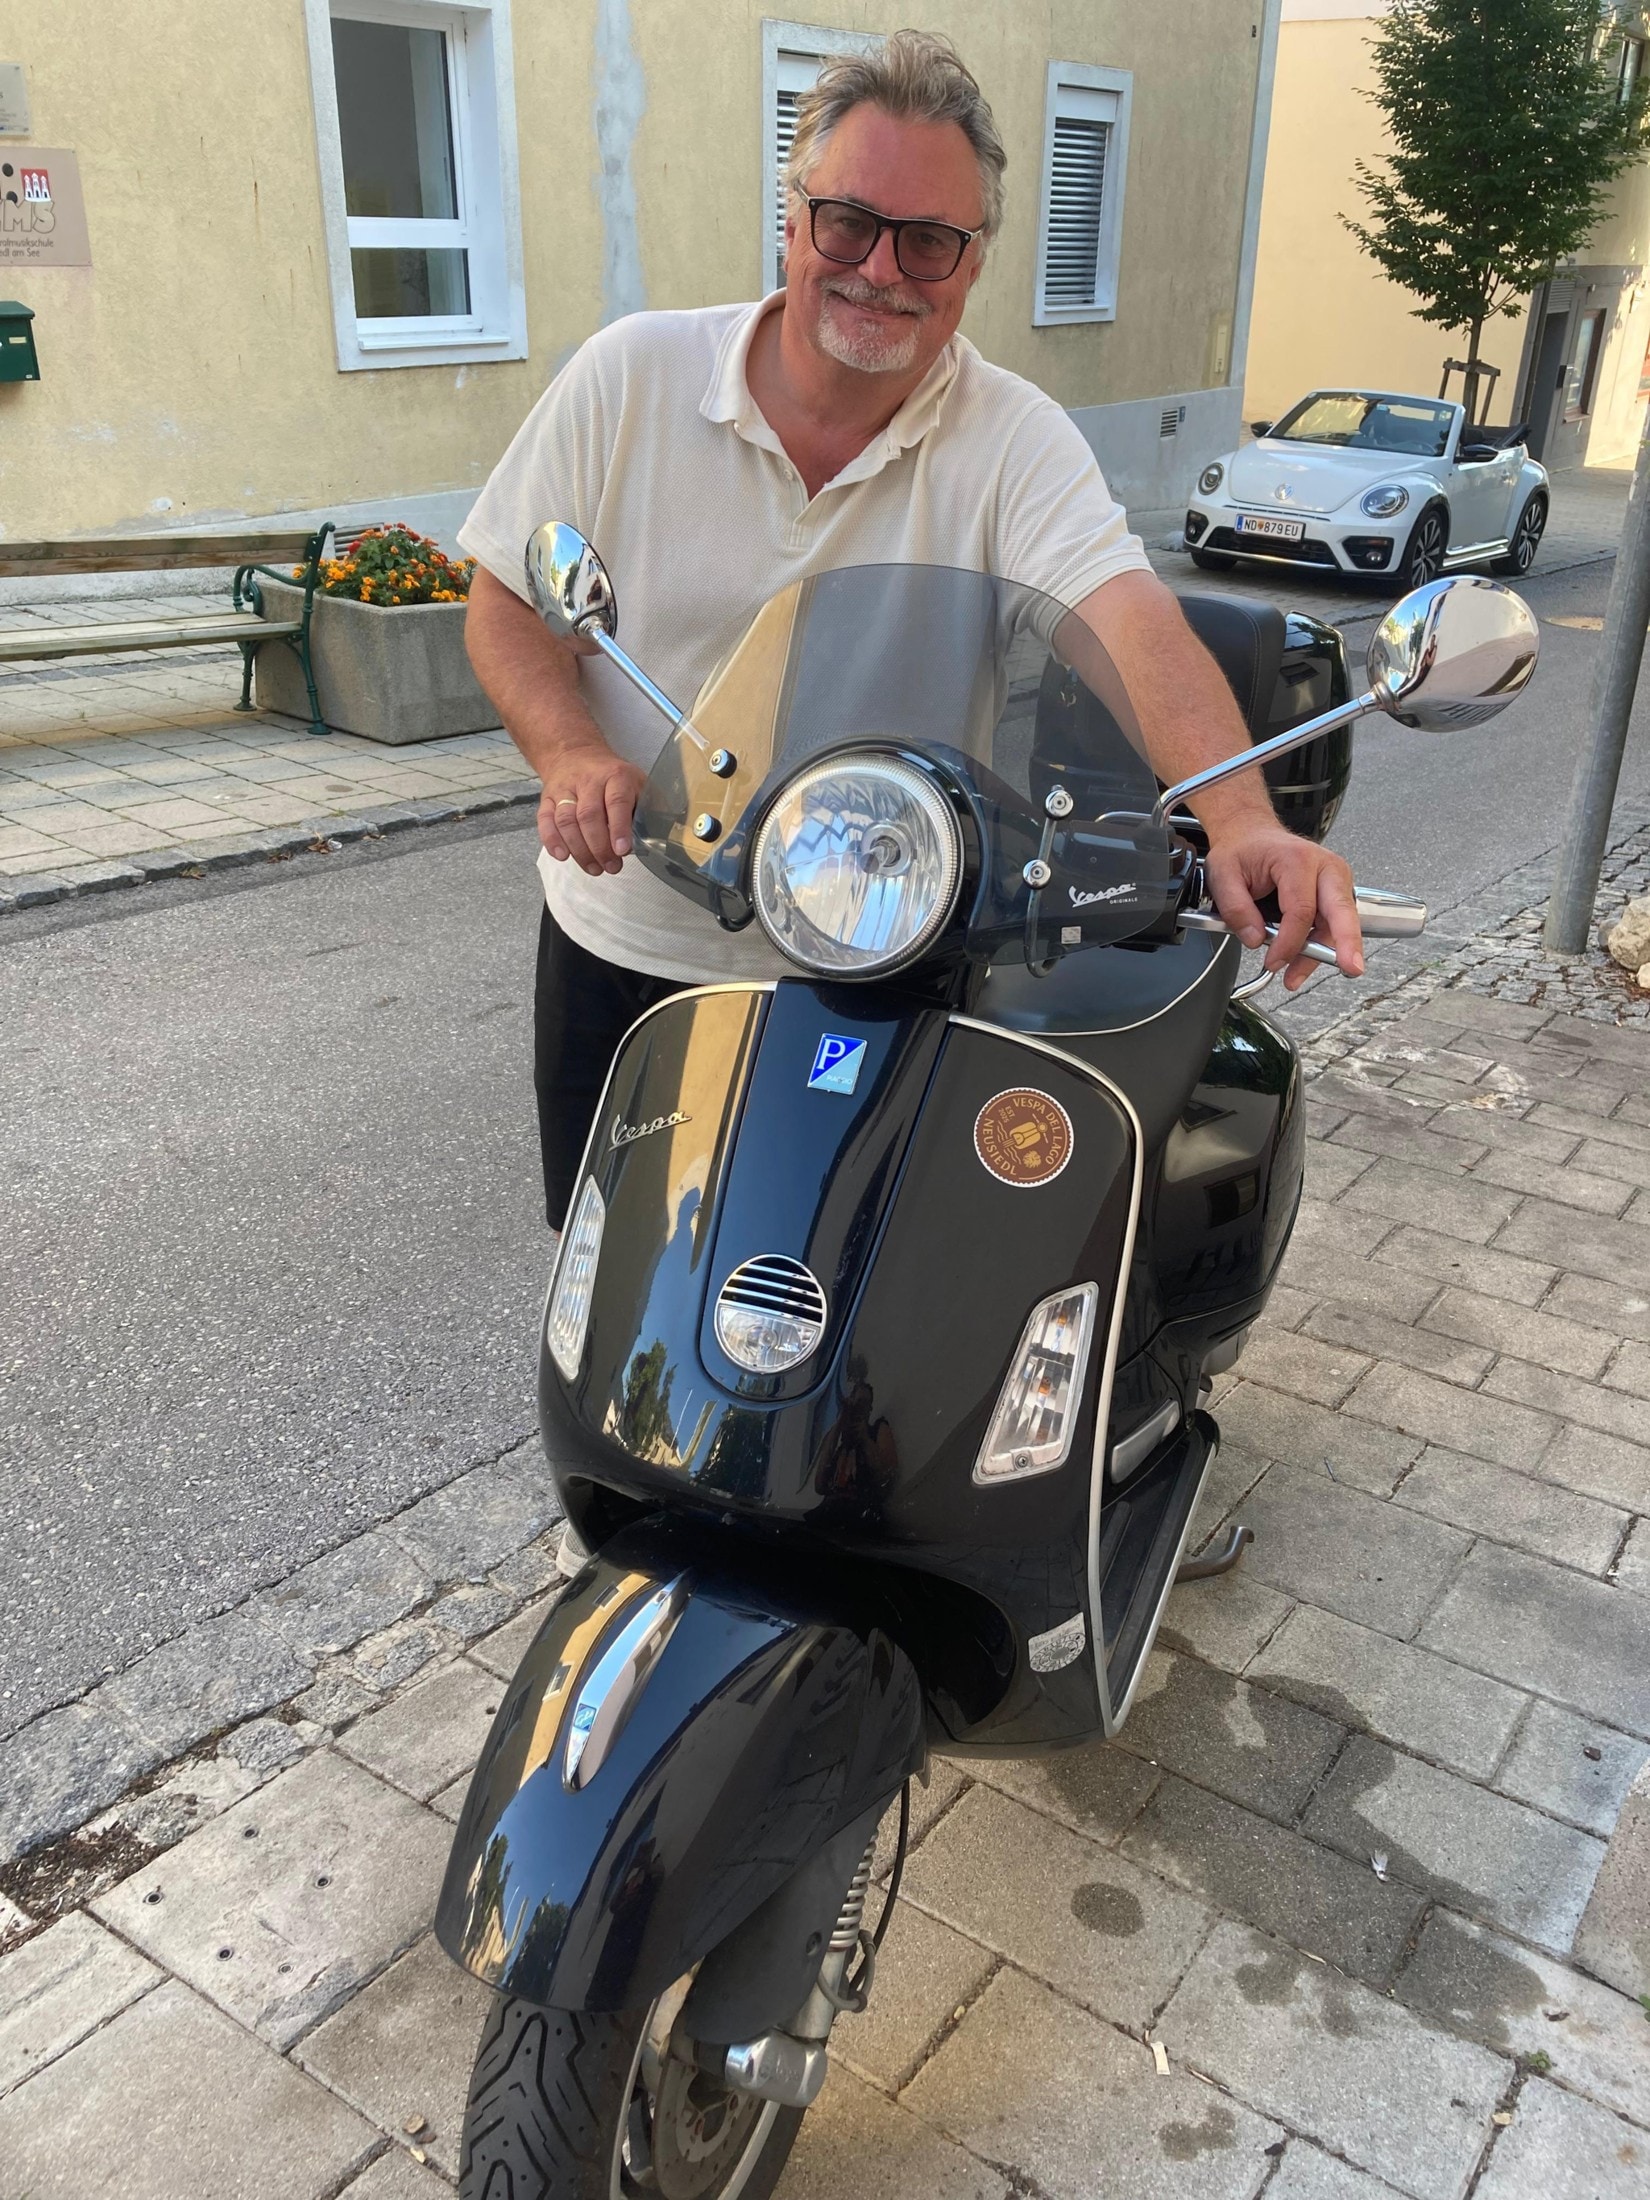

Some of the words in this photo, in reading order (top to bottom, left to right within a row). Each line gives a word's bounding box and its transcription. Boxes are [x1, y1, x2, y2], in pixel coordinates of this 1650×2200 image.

[0, 198, 56, 234] MS
[26, 247, 40, 257] See
[1244, 519, 1257, 531] ND
[1068, 883, 1137, 908] Vespa
[1013, 1098, 1046, 1115] VESPA
[608, 1111, 693, 1153] Vespa
[1046, 1112, 1060, 1133] DEL
[982, 1118, 1017, 1176] NEUSIEDL
[1045, 1135, 1063, 1165] LAGO
